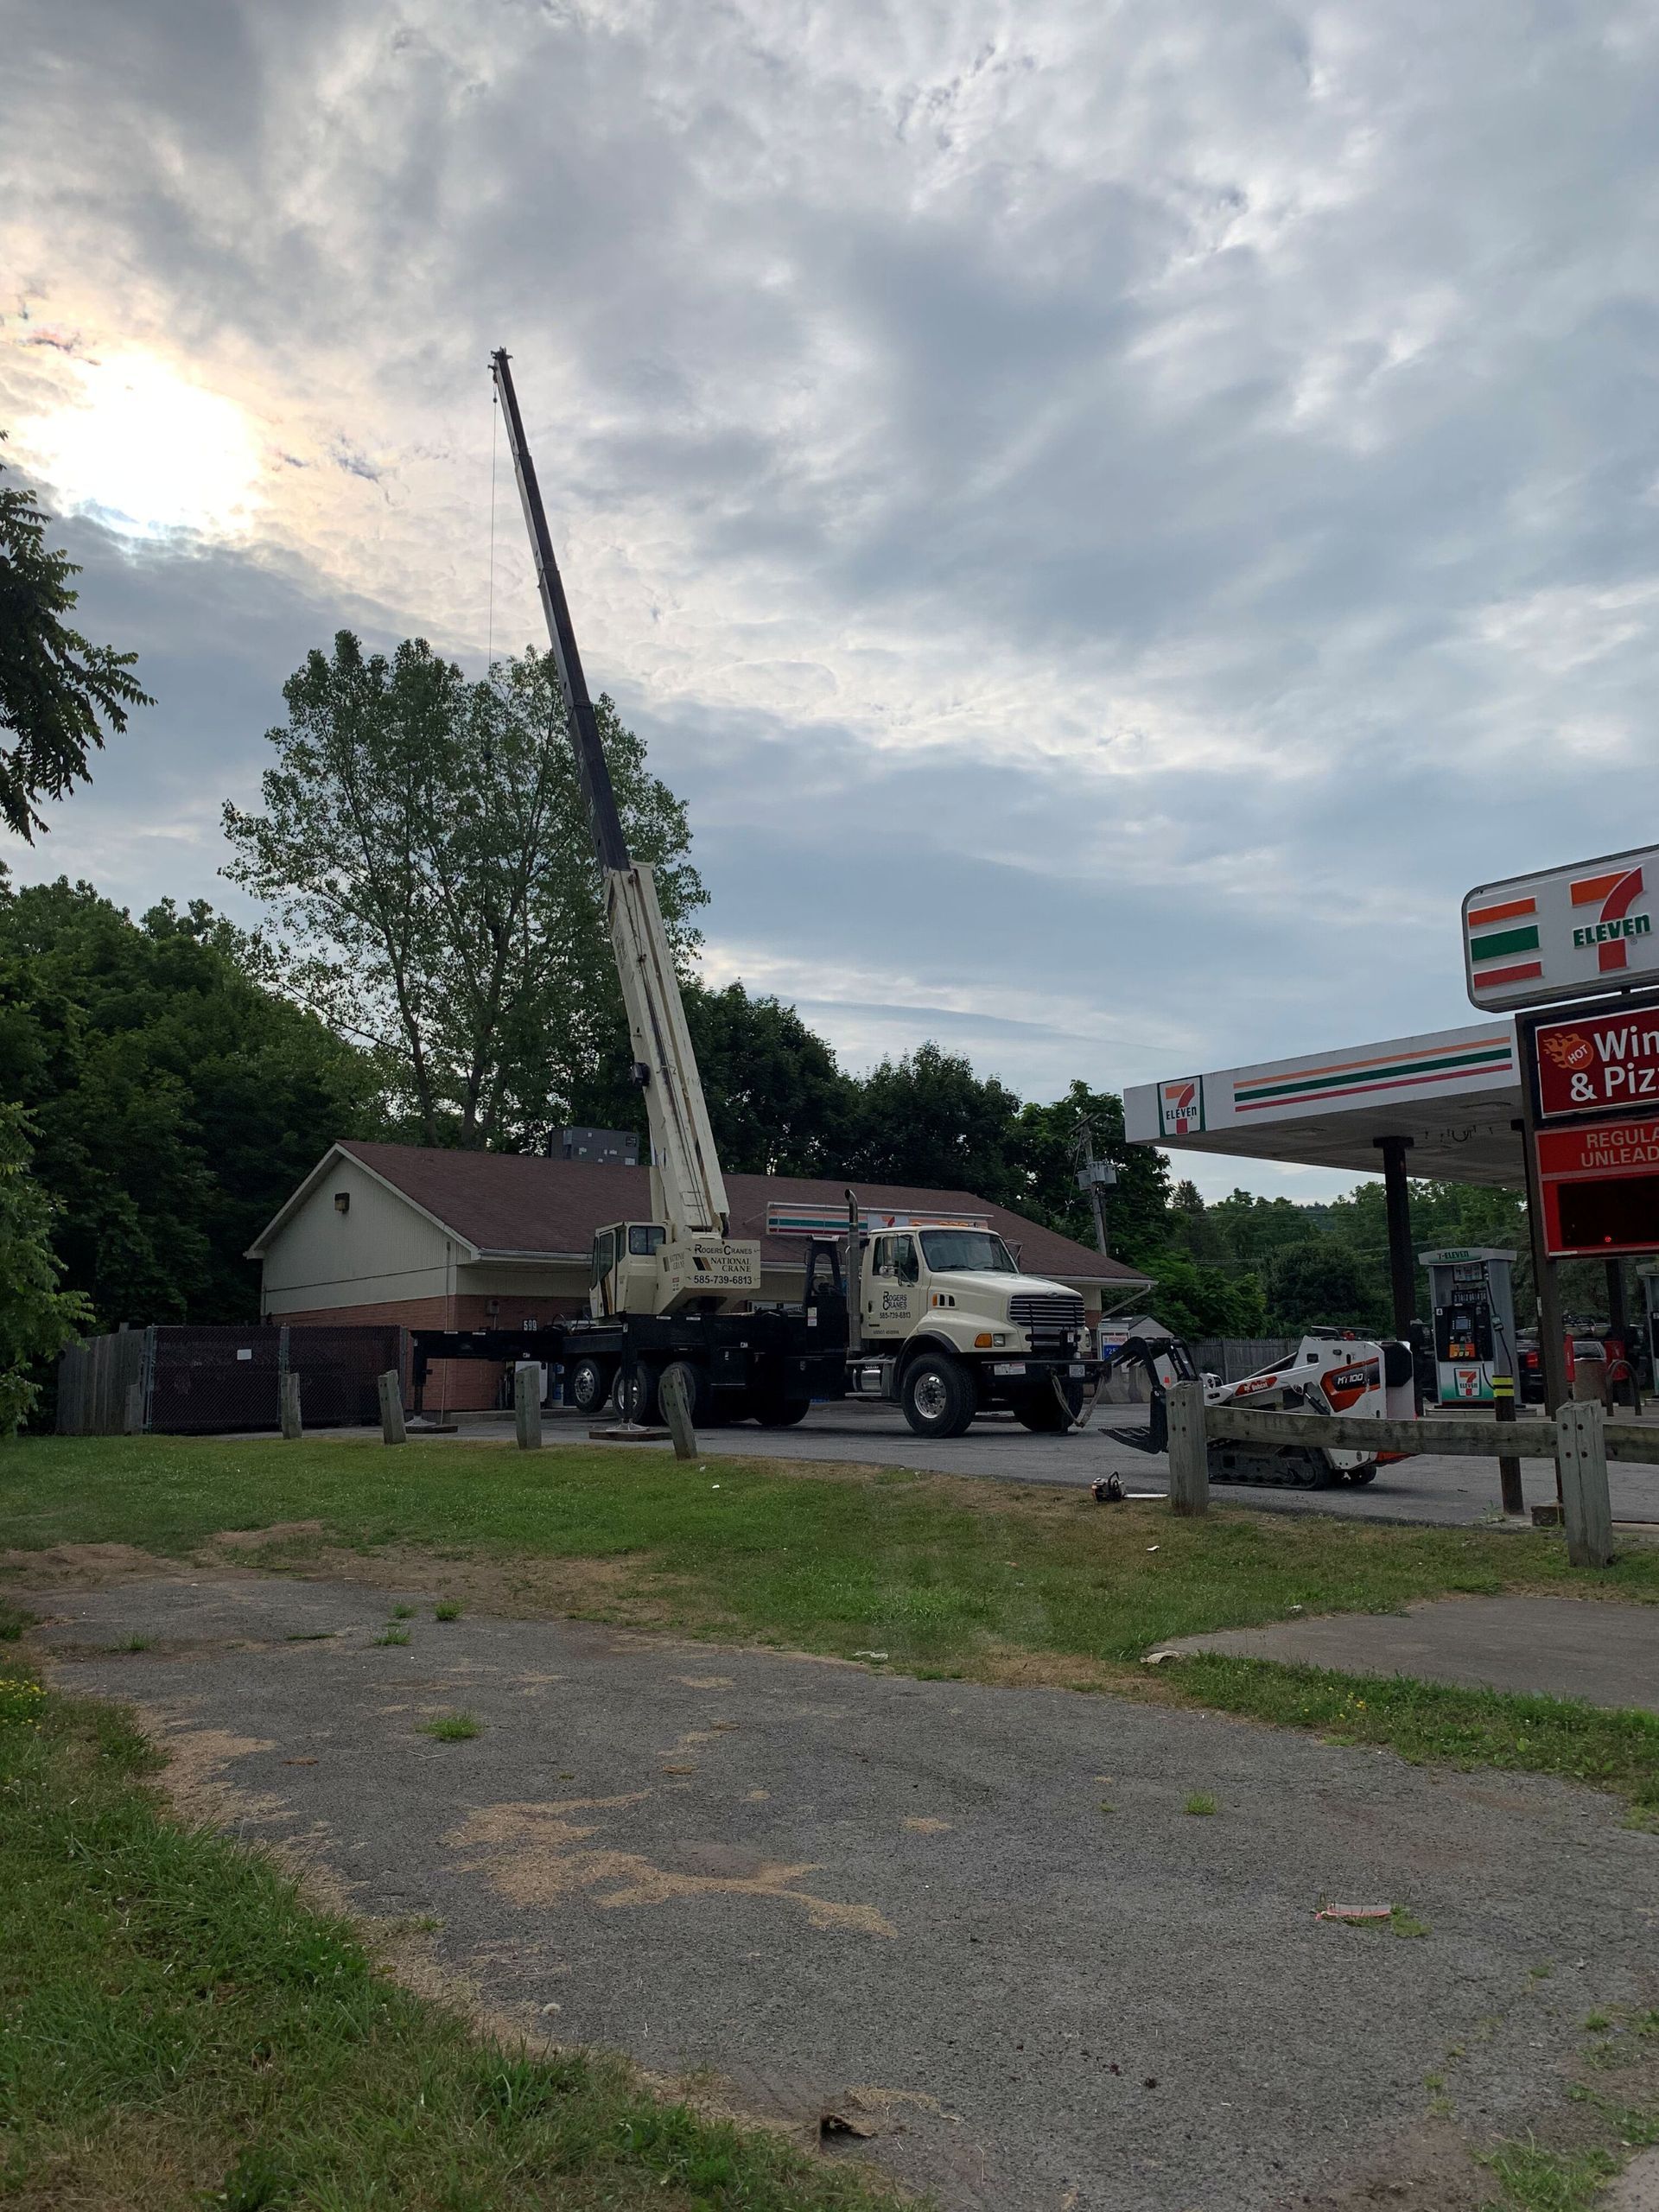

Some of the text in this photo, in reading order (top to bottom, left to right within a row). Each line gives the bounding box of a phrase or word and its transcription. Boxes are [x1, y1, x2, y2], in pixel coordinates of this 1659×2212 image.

[1569, 866, 1644, 973] 7
[1567, 1044, 1588, 1065] HOT
[1571, 1062, 1659, 1102] & Piz
[1165, 1083, 1195, 1135] 7
[723, 1245, 753, 1255] CRANES
[693, 1274, 753, 1285] 585-739-6813
